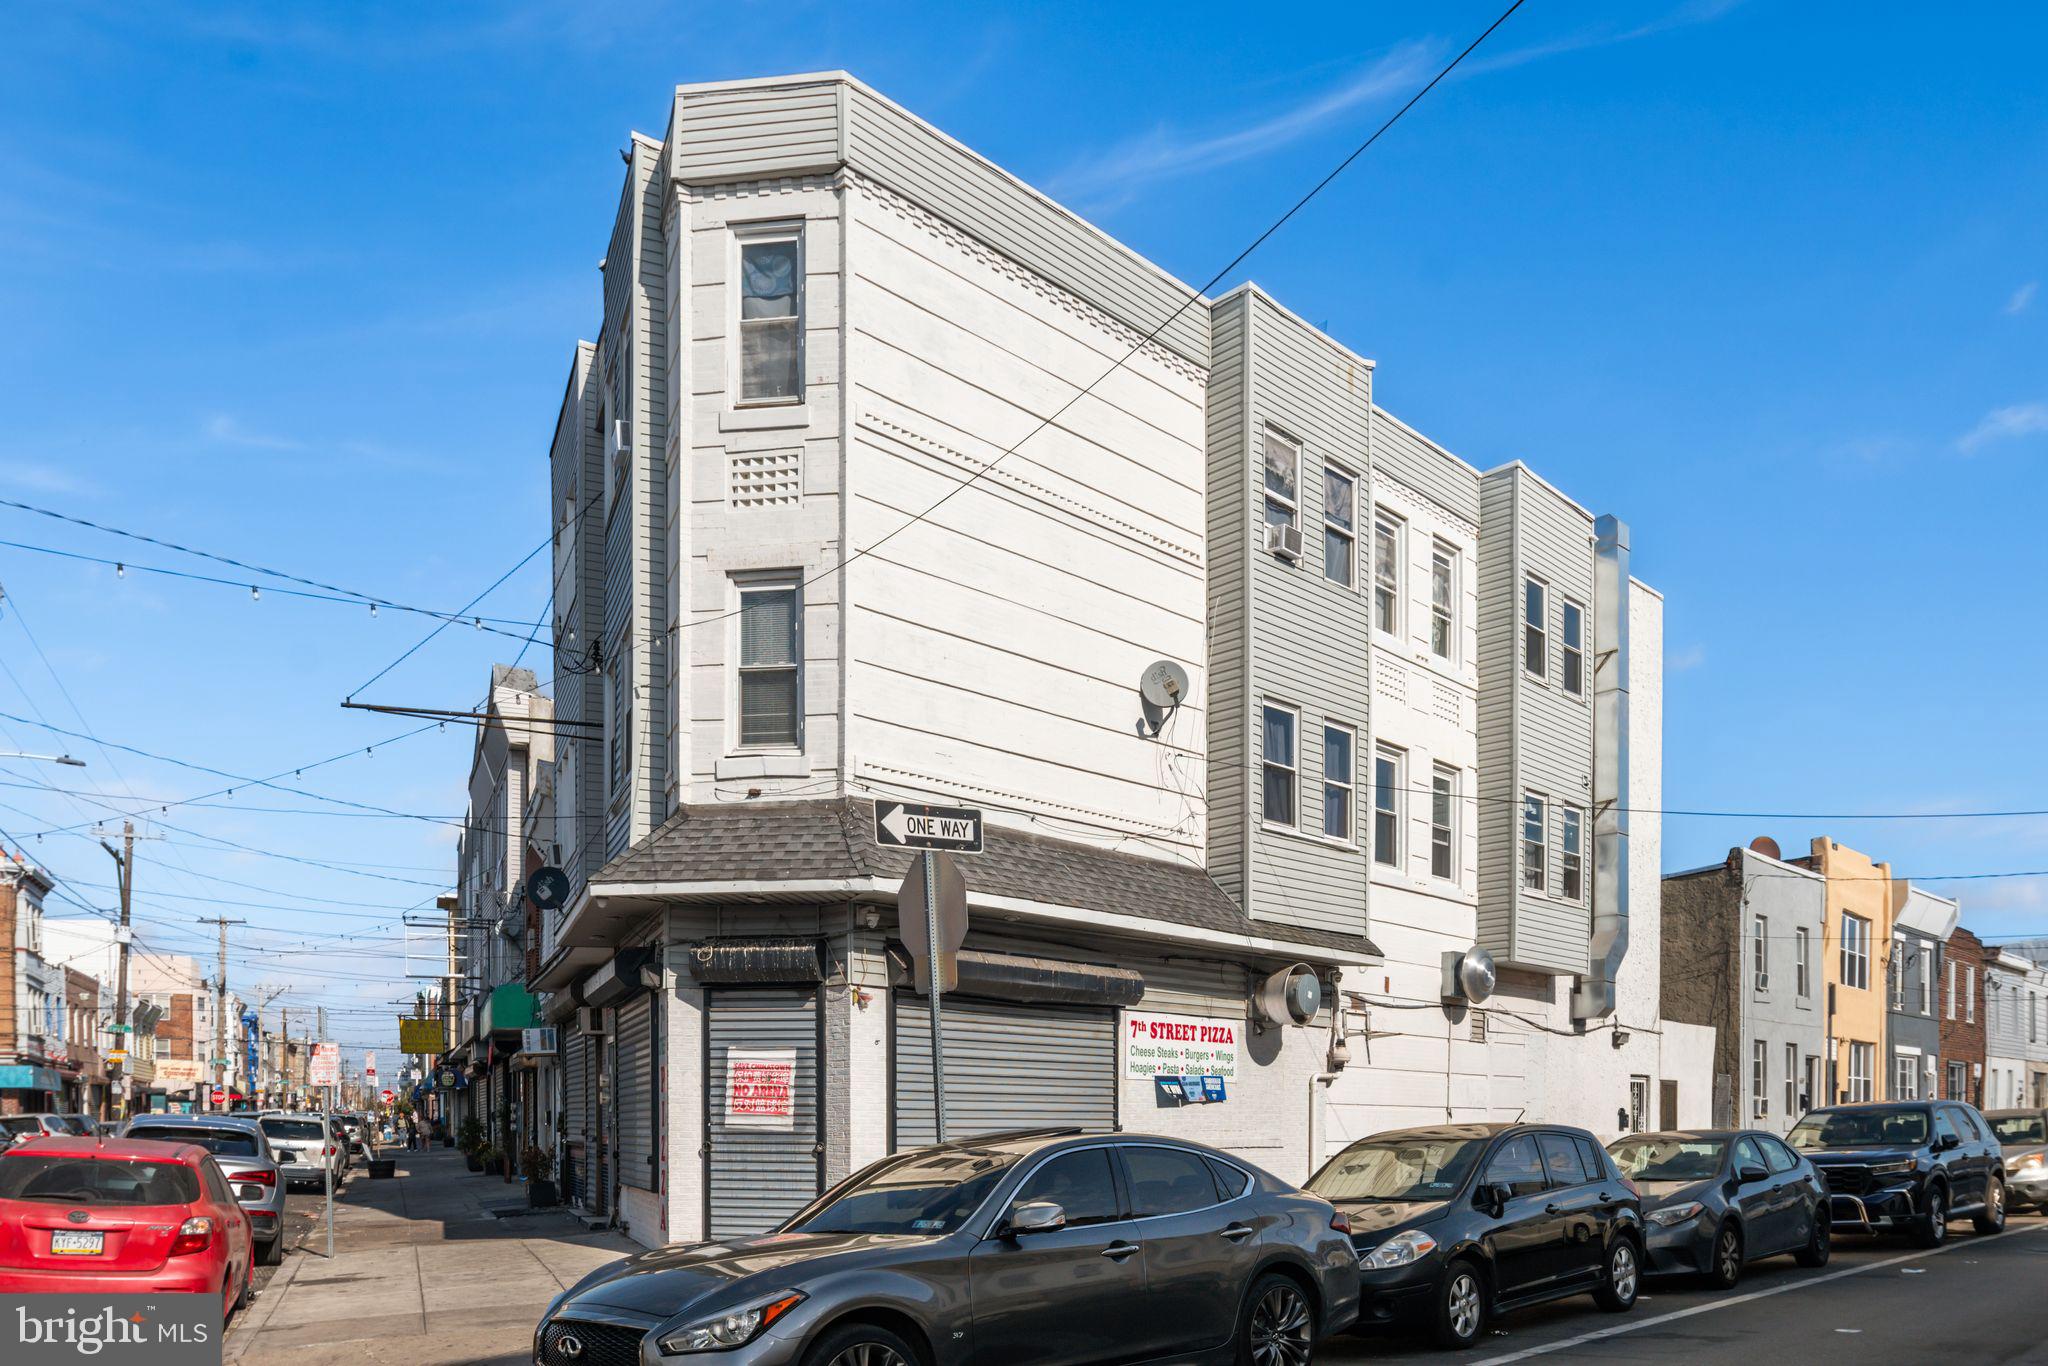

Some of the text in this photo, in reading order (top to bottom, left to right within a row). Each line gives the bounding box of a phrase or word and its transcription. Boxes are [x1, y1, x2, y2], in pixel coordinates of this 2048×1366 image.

[907, 816, 969, 838] ONE WAY
[1130, 1020, 1234, 1044] 7th STREET PIZZA
[1130, 1045, 1234, 1064] Cheese Steaks Burgers Wings
[751, 1063, 791, 1071] CHINATOWN
[1130, 1061, 1234, 1077] Hoagies Pasta Salads Seafood
[733, 1084, 789, 1098] NO ARENA
